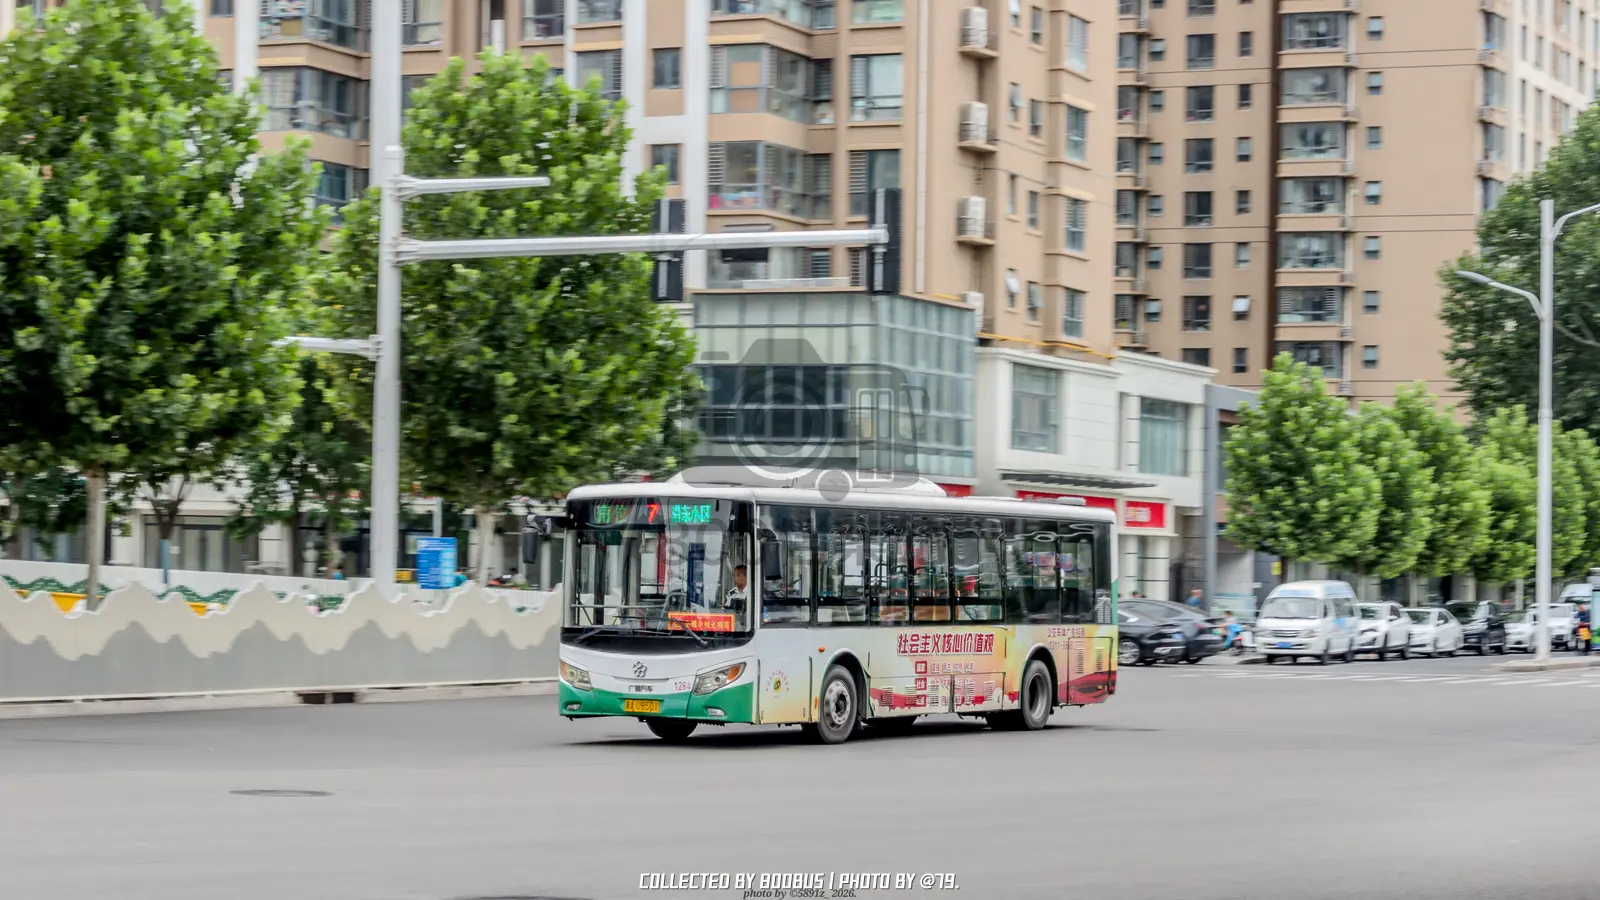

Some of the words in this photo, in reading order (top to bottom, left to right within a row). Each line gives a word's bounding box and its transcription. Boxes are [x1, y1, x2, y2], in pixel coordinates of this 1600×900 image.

[647, 504, 659, 523] 7
[898, 633, 994, 655] 社会主义核心价值观
[674, 681, 691, 691] 1264
